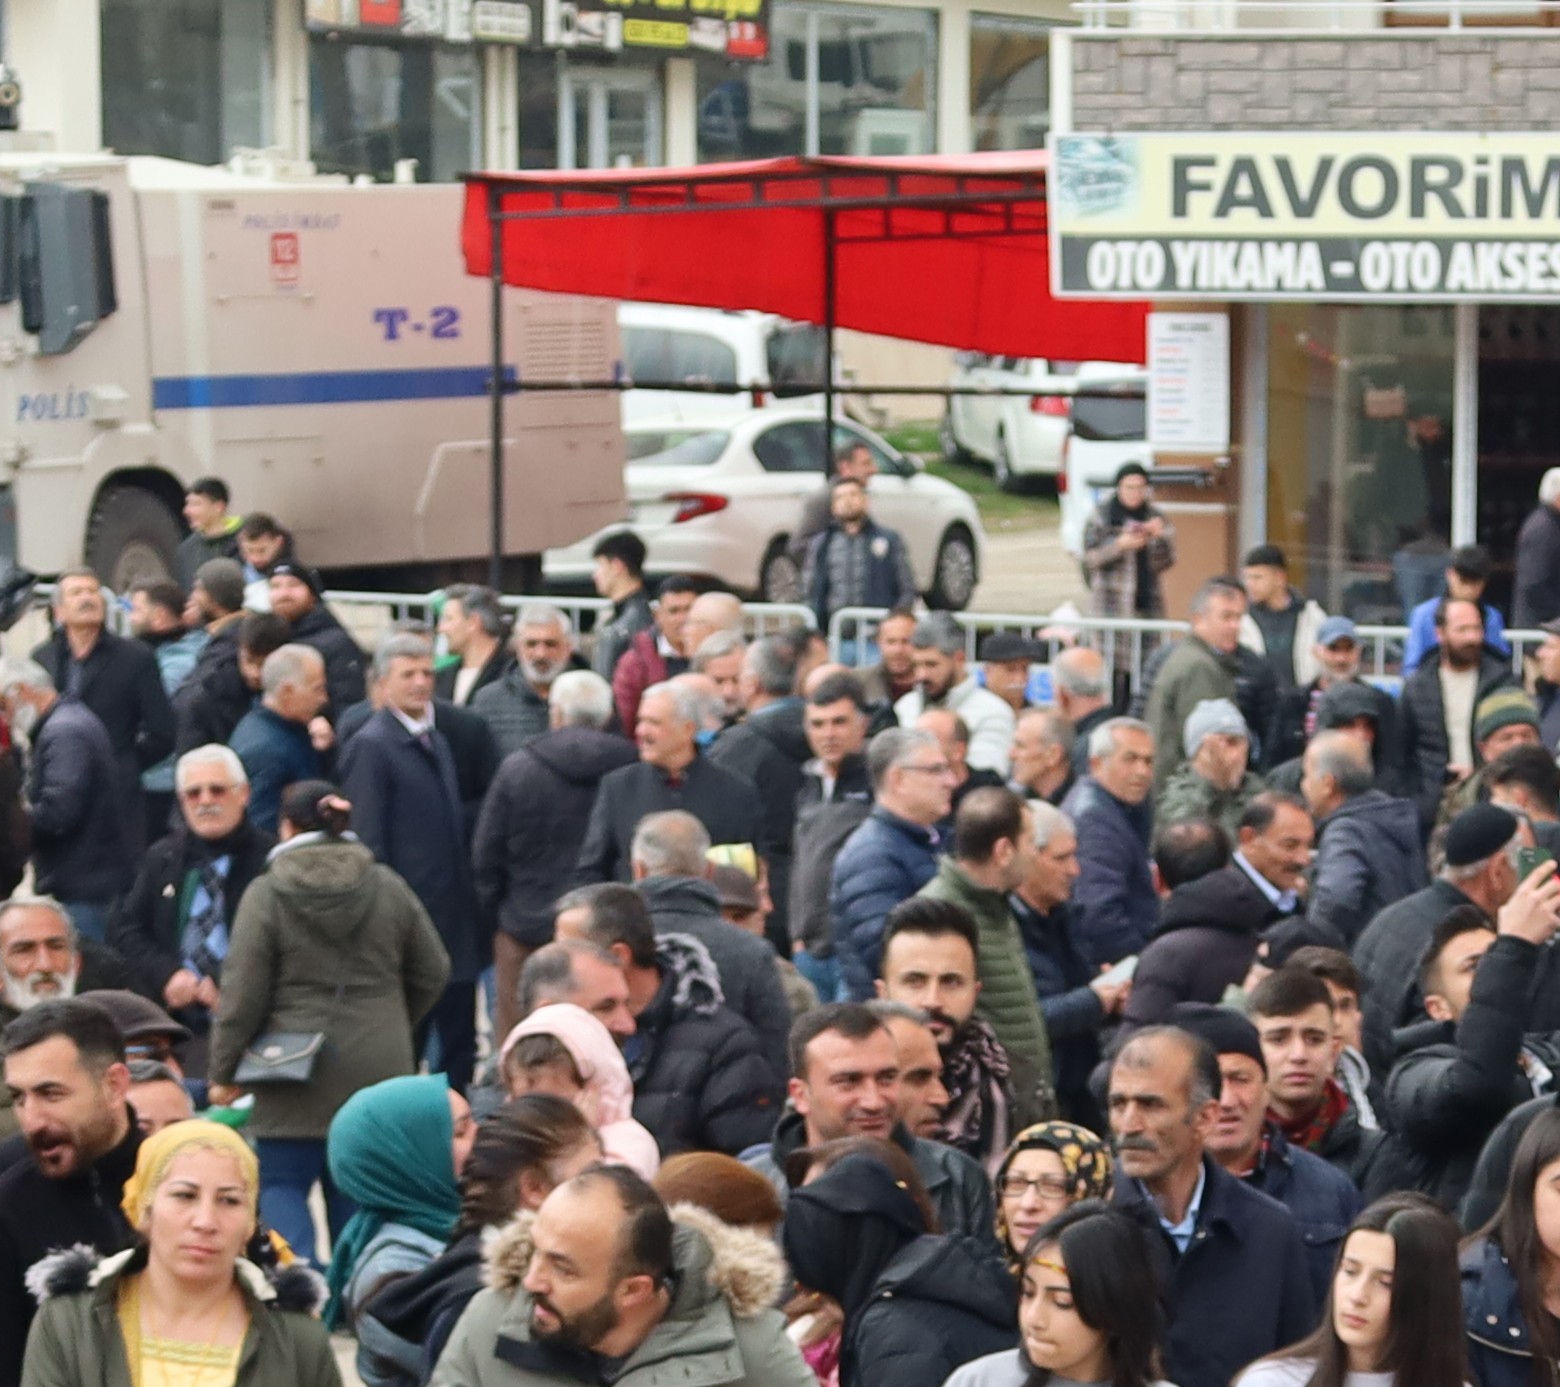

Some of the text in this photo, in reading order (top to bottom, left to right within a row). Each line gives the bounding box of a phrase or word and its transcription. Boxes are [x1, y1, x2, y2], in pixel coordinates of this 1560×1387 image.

[1087, 240, 1166, 291] OTO
[1171, 240, 1324, 291] YIKAMA
[1360, 240, 1438, 291] OTO
[374, 306, 461, 341] T-2
